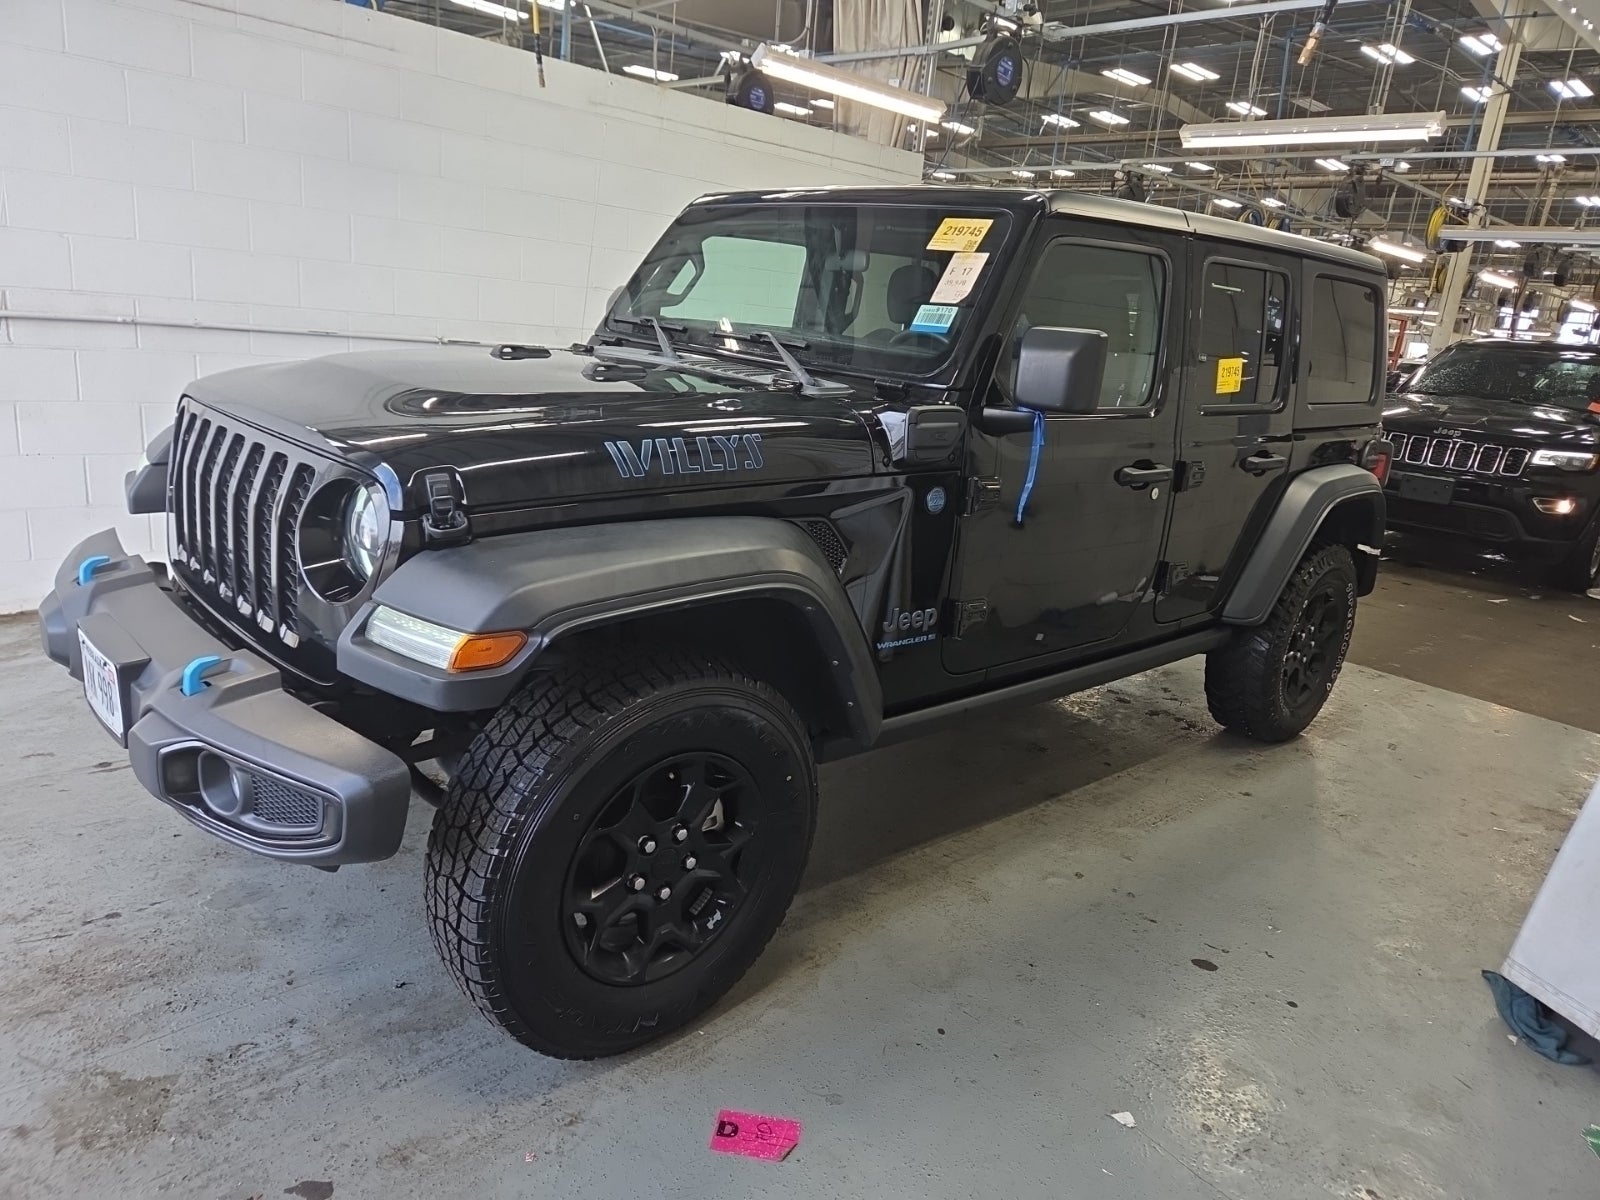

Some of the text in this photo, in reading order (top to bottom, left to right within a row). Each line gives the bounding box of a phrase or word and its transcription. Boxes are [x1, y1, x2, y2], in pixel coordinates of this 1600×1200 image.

[943, 226, 984, 237] 219745
[961, 267, 974, 276] 17
[1221, 366, 1240, 378] 219745
[1433, 427, 1462, 438] Jeep
[604, 433, 764, 478] WILLYS
[882, 607, 938, 633] Jeep
[876, 635, 927, 650] WRANGLER
[716, 1120, 739, 1138] D
